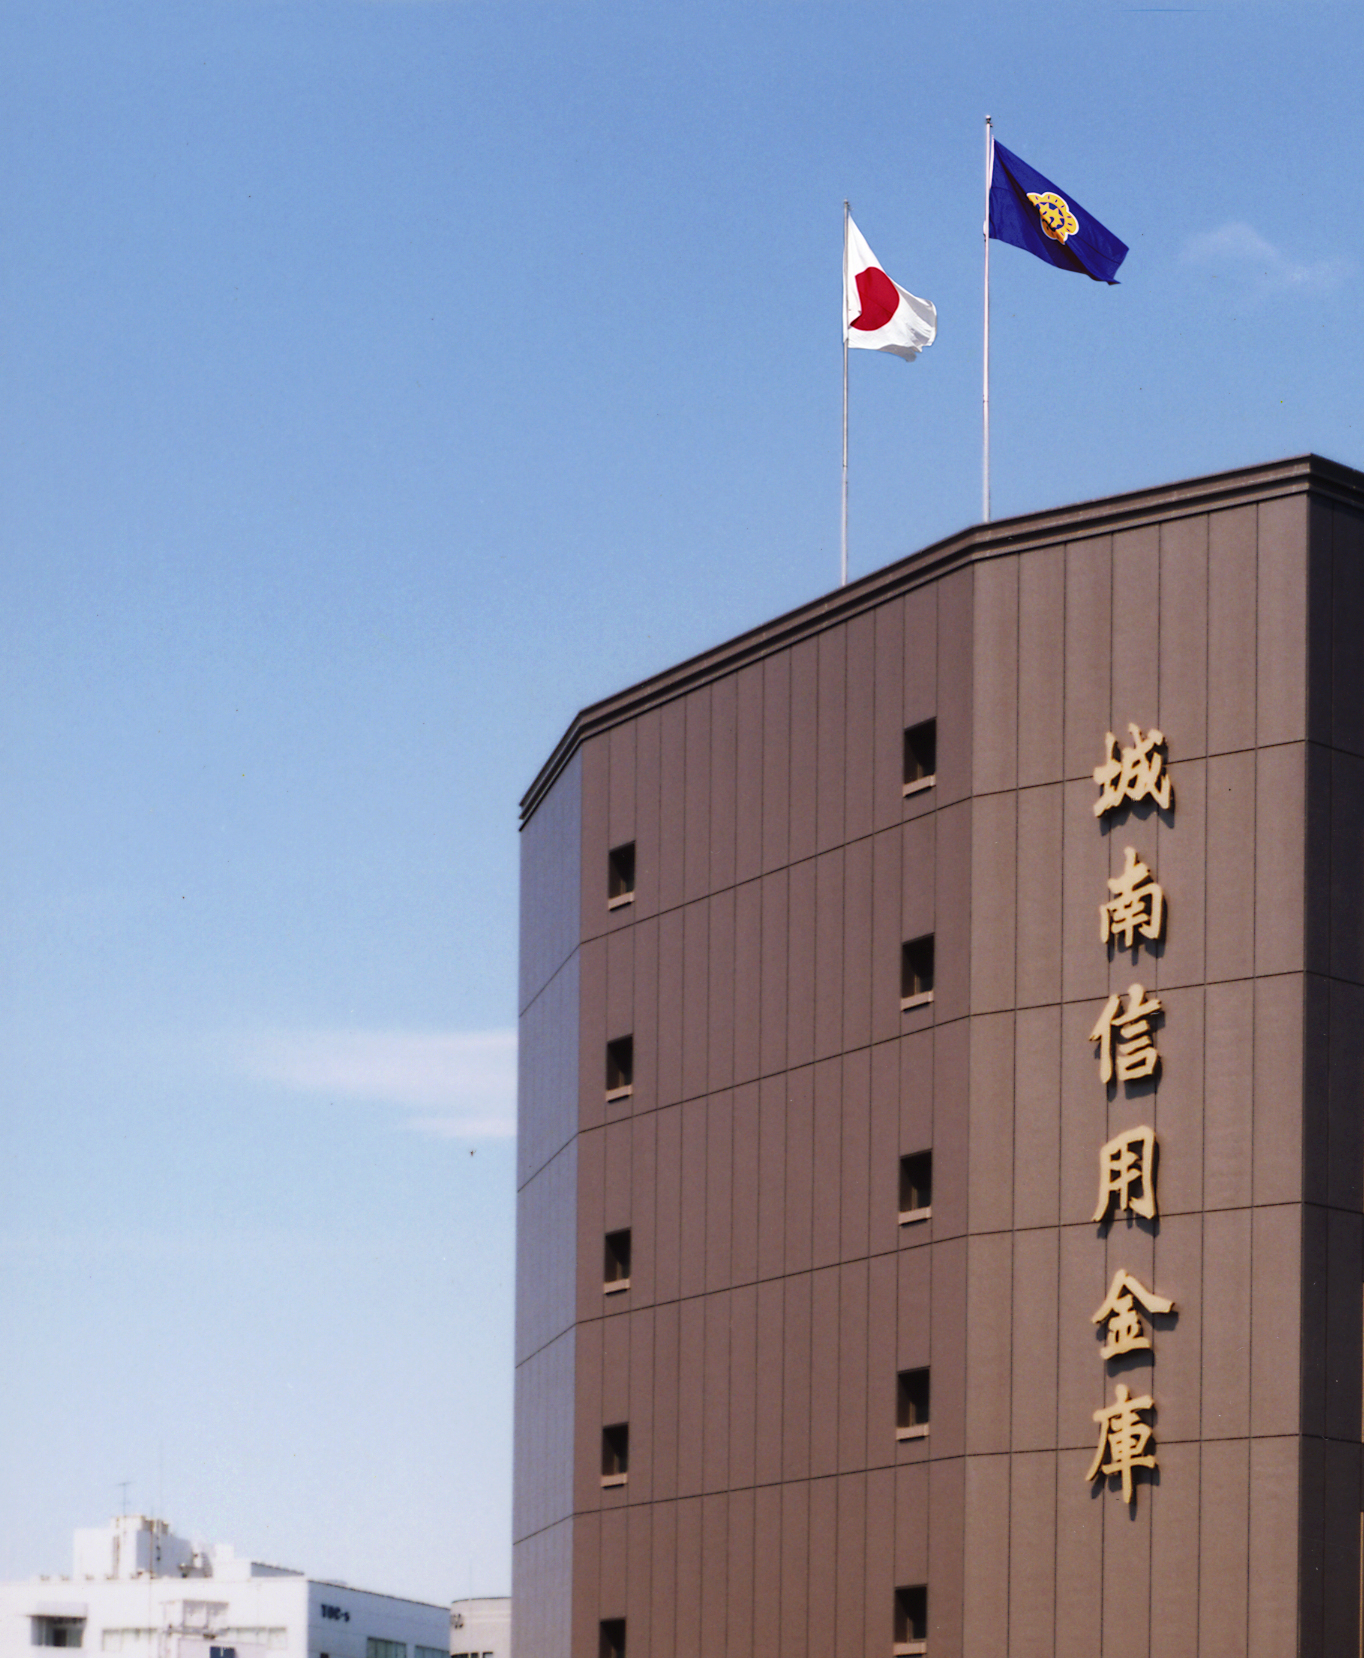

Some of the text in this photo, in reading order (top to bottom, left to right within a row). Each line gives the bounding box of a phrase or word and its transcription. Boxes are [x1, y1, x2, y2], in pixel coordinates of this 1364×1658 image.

[1086, 723, 1174, 1504] 城南信用金庫
